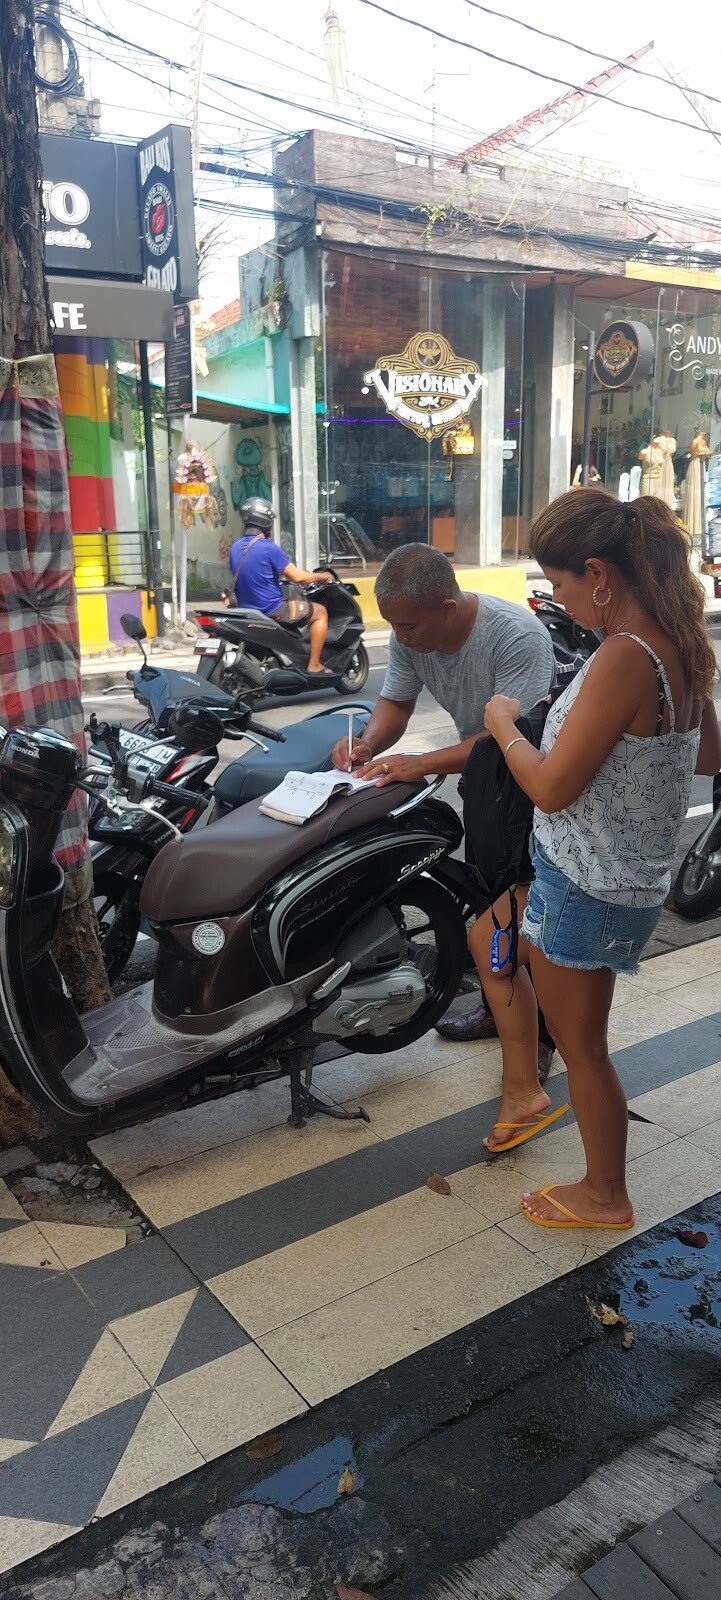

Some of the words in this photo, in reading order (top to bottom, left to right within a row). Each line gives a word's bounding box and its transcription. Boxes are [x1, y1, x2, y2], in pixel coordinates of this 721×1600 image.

[364, 368, 489, 410] VISIONARY
[10, 743, 41, 760] HONDA
[400, 847, 446, 876] Scoopy
